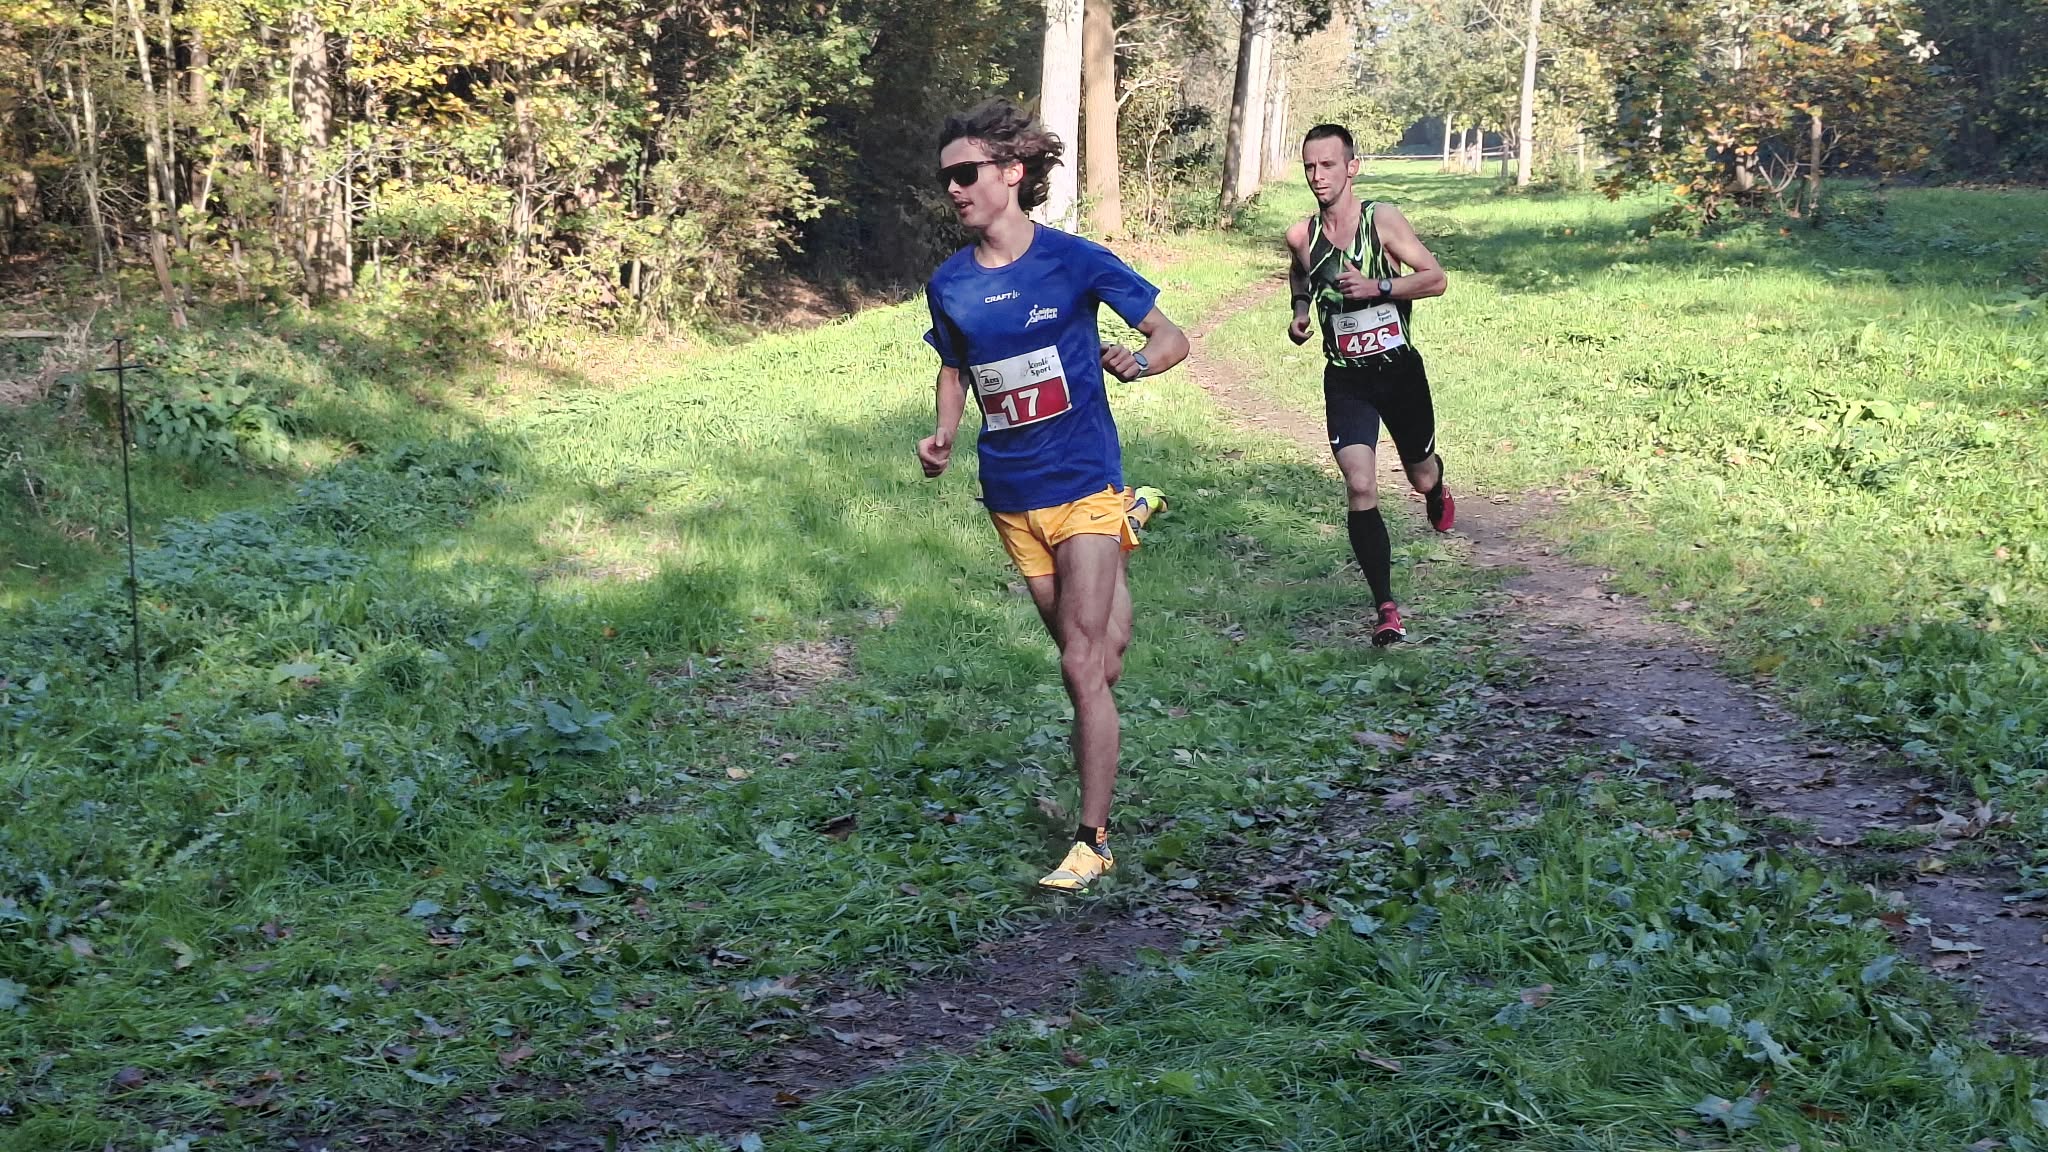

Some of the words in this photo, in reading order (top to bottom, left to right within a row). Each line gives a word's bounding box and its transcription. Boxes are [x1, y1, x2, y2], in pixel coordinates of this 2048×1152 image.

[985, 292, 1012, 303] CRAFT
[1347, 327, 1392, 354] 426
[1001, 387, 1040, 421] 17
